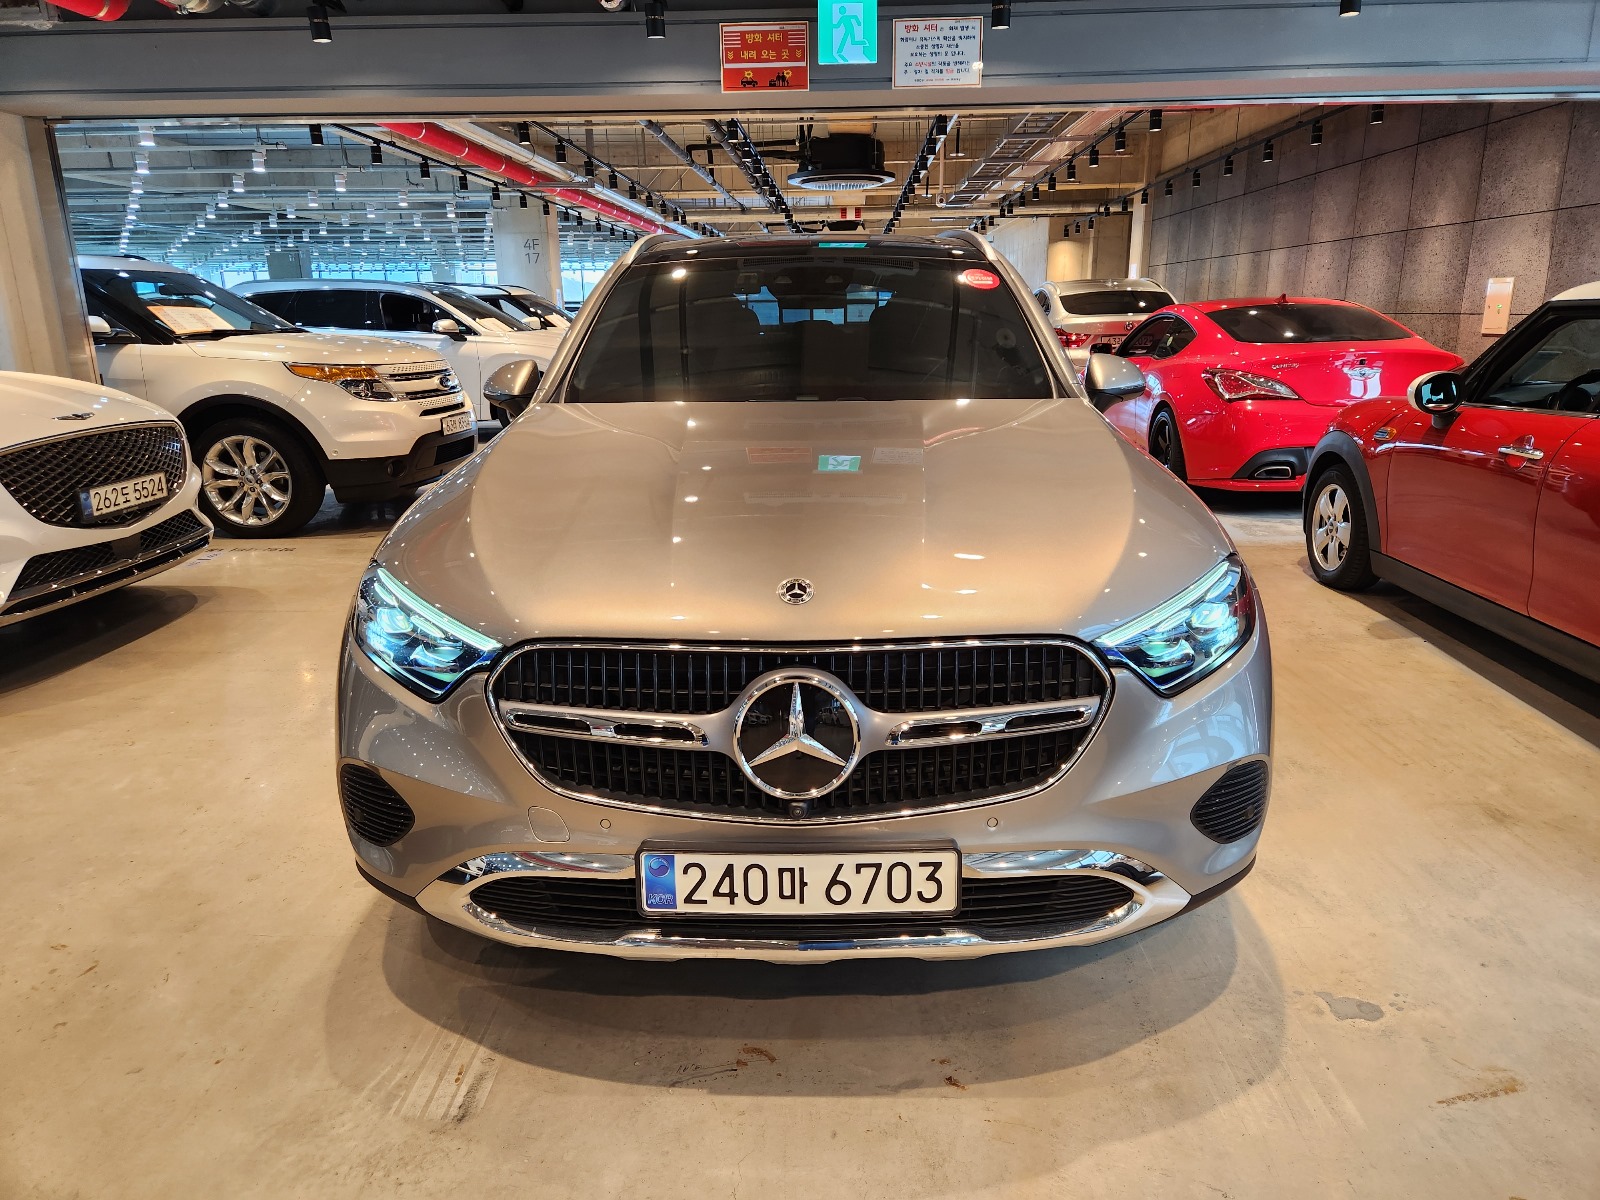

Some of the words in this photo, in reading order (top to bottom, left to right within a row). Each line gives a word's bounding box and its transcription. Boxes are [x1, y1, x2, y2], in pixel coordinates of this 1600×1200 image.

[904, 24, 919, 33] 방화
[923, 23, 938, 32] 셔터
[746, 33, 763, 44] 방화
[767, 32, 783, 42] 셔터
[740, 50, 757, 60] 내려
[761, 49, 777, 59] 오는
[781, 49, 790, 59] 곳
[523, 238, 540, 250] 4F
[525, 252, 540, 264] 17
[93, 485, 131, 512] 262도
[133, 476, 165, 501] 5524
[682, 861, 808, 906] 240마
[824, 860, 943, 906] 6703
[648, 893, 674, 905] KOR
